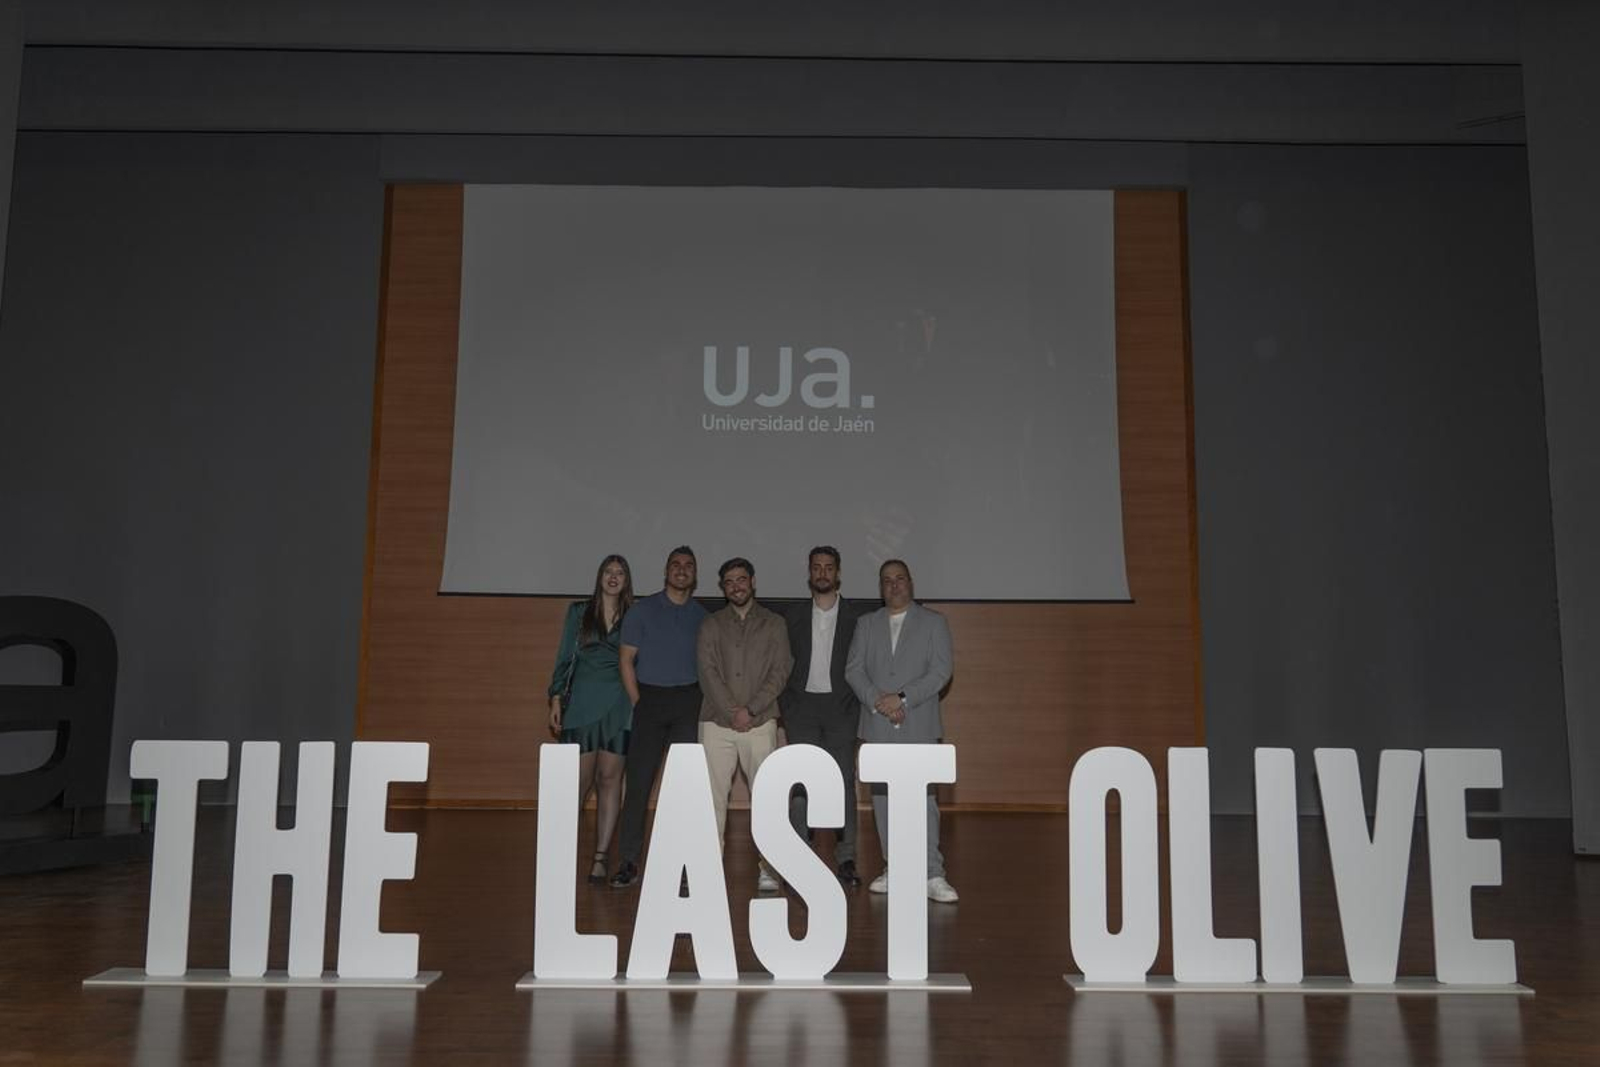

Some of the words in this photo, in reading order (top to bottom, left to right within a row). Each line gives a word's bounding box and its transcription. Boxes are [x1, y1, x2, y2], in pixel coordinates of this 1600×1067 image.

[702, 414, 803, 431] Universidad
[808, 416, 829, 431] de
[833, 415, 874, 433] Jaén
[129, 740, 429, 978] THE
[534, 743, 956, 980] LAST
[1068, 746, 1517, 984] OLIVE
